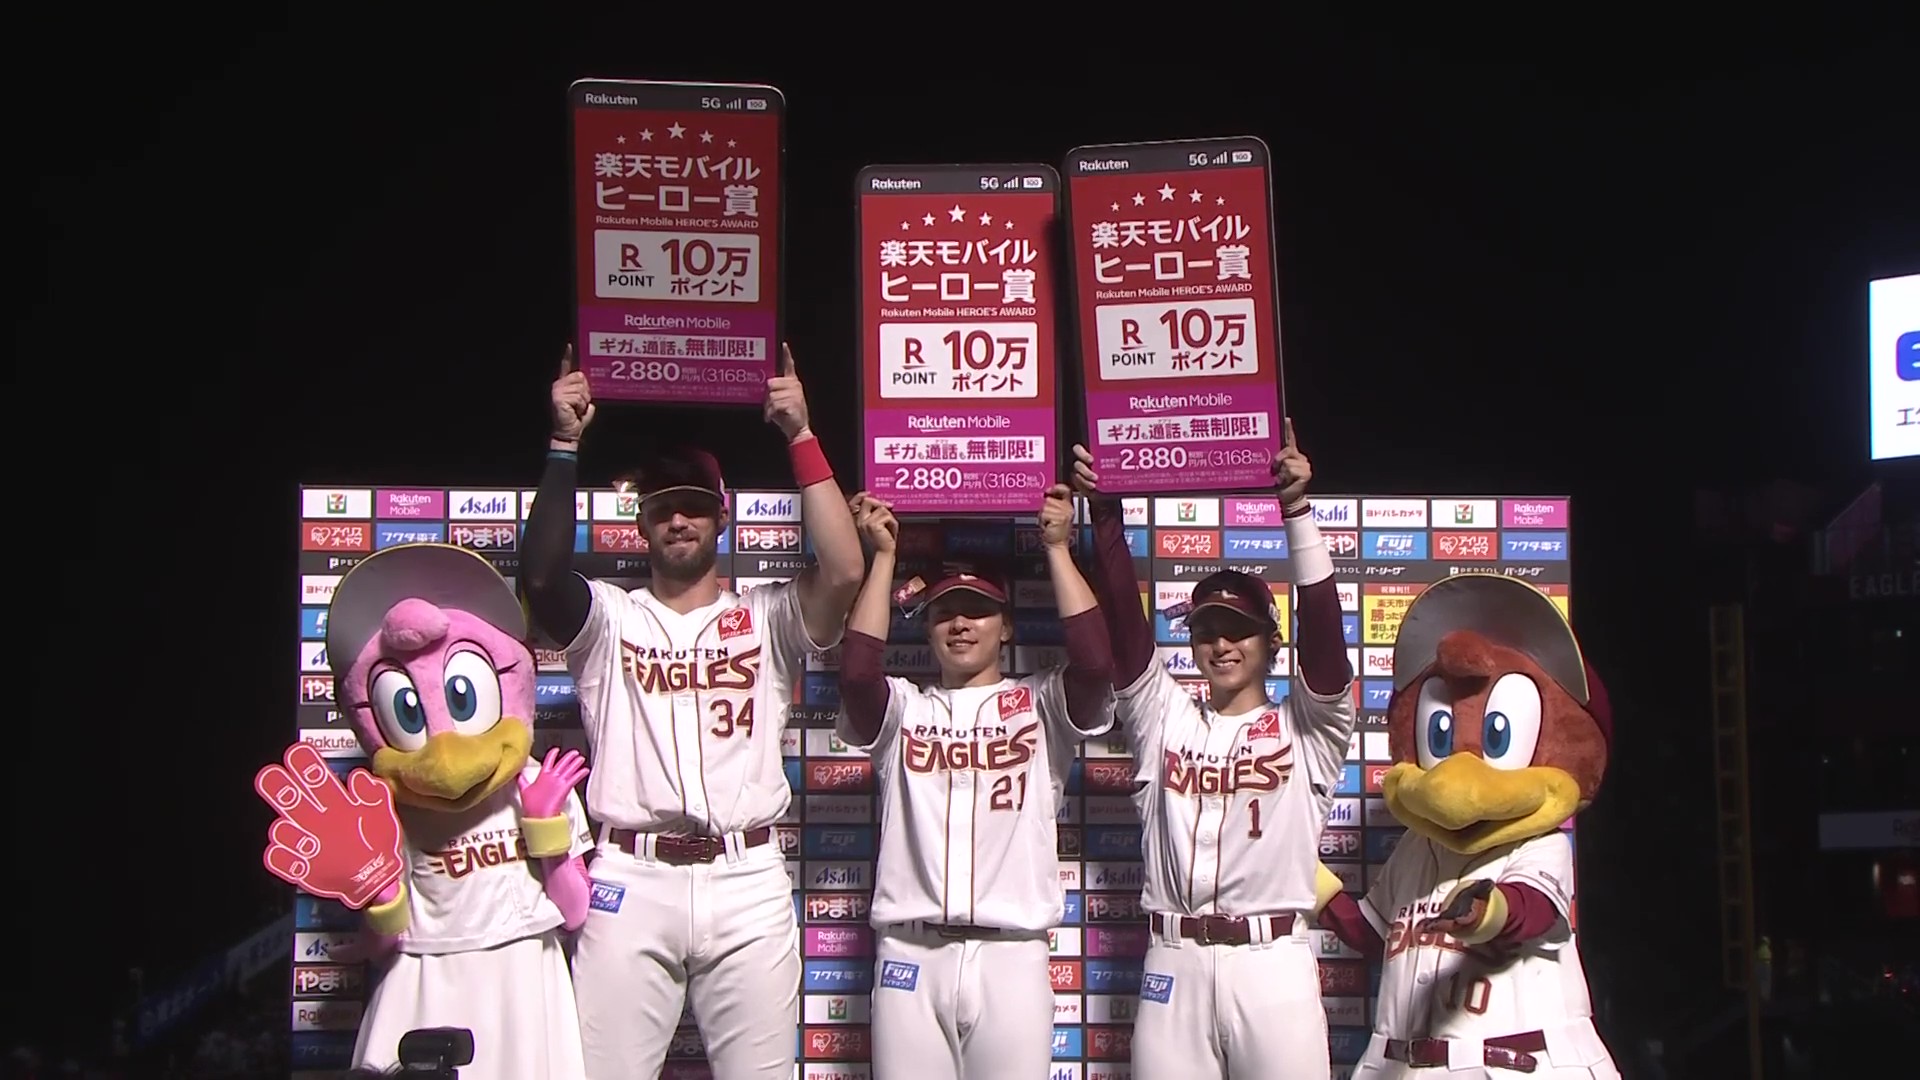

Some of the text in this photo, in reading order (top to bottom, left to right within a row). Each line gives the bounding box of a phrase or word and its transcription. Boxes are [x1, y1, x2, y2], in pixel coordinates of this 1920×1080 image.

[585, 92, 638, 106] Rakuten
[701, 98, 721, 109] 5G
[595, 153, 761, 181] 楽天モバイル
[1079, 158, 1129, 171] Rakuten
[1189, 154, 1208, 166] 5G
[872, 178, 921, 190] Rakuten
[980, 178, 999, 189] 5G
[596, 182, 759, 217] ヒーロー賞
[596, 215, 638, 226] Rakuten
[640, 216, 673, 226] Mobile
[720, 220, 759, 229] AWARD
[1091, 214, 1250, 248] 楽天モバイル
[661, 239, 751, 277] 10万
[880, 239, 1038, 267] 楽天モバイル
[1094, 245, 1252, 283] ヒーロー賞
[608, 275, 655, 287] POINT
[671, 278, 744, 296] ポイント
[881, 269, 1036, 304] ヒーロー賞
[1096, 288, 1136, 299] Rakuten
[1138, 287, 1170, 297] Mobile
[1215, 283, 1252, 293] AWARD
[881, 308, 921, 318] Rakuten
[923, 308, 955, 317] Mobile
[999, 307, 1036, 316] AWARD
[625, 314, 730, 329] Rakuten Mobile
[1160, 308, 1247, 349] 10万
[943, 330, 1029, 370] 10万
[1112, 352, 1156, 366] POINT
[1172, 350, 1243, 371] ポイント
[611, 361, 680, 381] 2,880
[892, 372, 937, 385] POINT
[952, 373, 1023, 392] ポイント
[1130, 393, 1232, 410] Rakuten Mobile
[908, 415, 1010, 430] Rakuten Mobile
[1120, 447, 1186, 470] 2,880
[895, 468, 962, 489] 2,880
[390, 494, 431, 504] Rakuten
[460, 497, 507, 514] Asahi
[390, 506, 420, 515] Mobile
[746, 499, 792, 516] Asahi
[1236, 502, 1276, 512] Rakuten
[1514, 504, 1554, 514] Rakuten
[1236, 515, 1265, 523] Mobile
[1514, 516, 1544, 525] Mobile
[331, 527, 362, 537] アイリス
[454, 528, 514, 548] やまや
[741, 530, 798, 548] やまや
[1182, 534, 1212, 544] アイリス
[331, 537, 362, 547] オーヤマ
[1376, 535, 1413, 550] Fuji
[1459, 536, 1488, 546] アイリス
[1181, 544, 1211, 554] オーヤマ
[1459, 546, 1488, 556] オーヤマ
[769, 561, 808, 569] PERSOL
[636, 647, 728, 661] RAKUTEN
[636, 645, 761, 693] EAGLES
[710, 698, 754, 737] 34
[915, 725, 1007, 739] RAKUTEN
[904, 722, 1038, 772] EAGLES
[990, 772, 1027, 810] 21
[1249, 799, 1262, 838] 1
[816, 867, 861, 885] Asahi
[1096, 863, 1141, 885] Asahi
[809, 899, 868, 918] やまや
[817, 931, 858, 941] Rakuten
[817, 943, 848, 952] Mobile
[884, 963, 915, 980] Fuji
[1446, 972, 1492, 1016] 10
